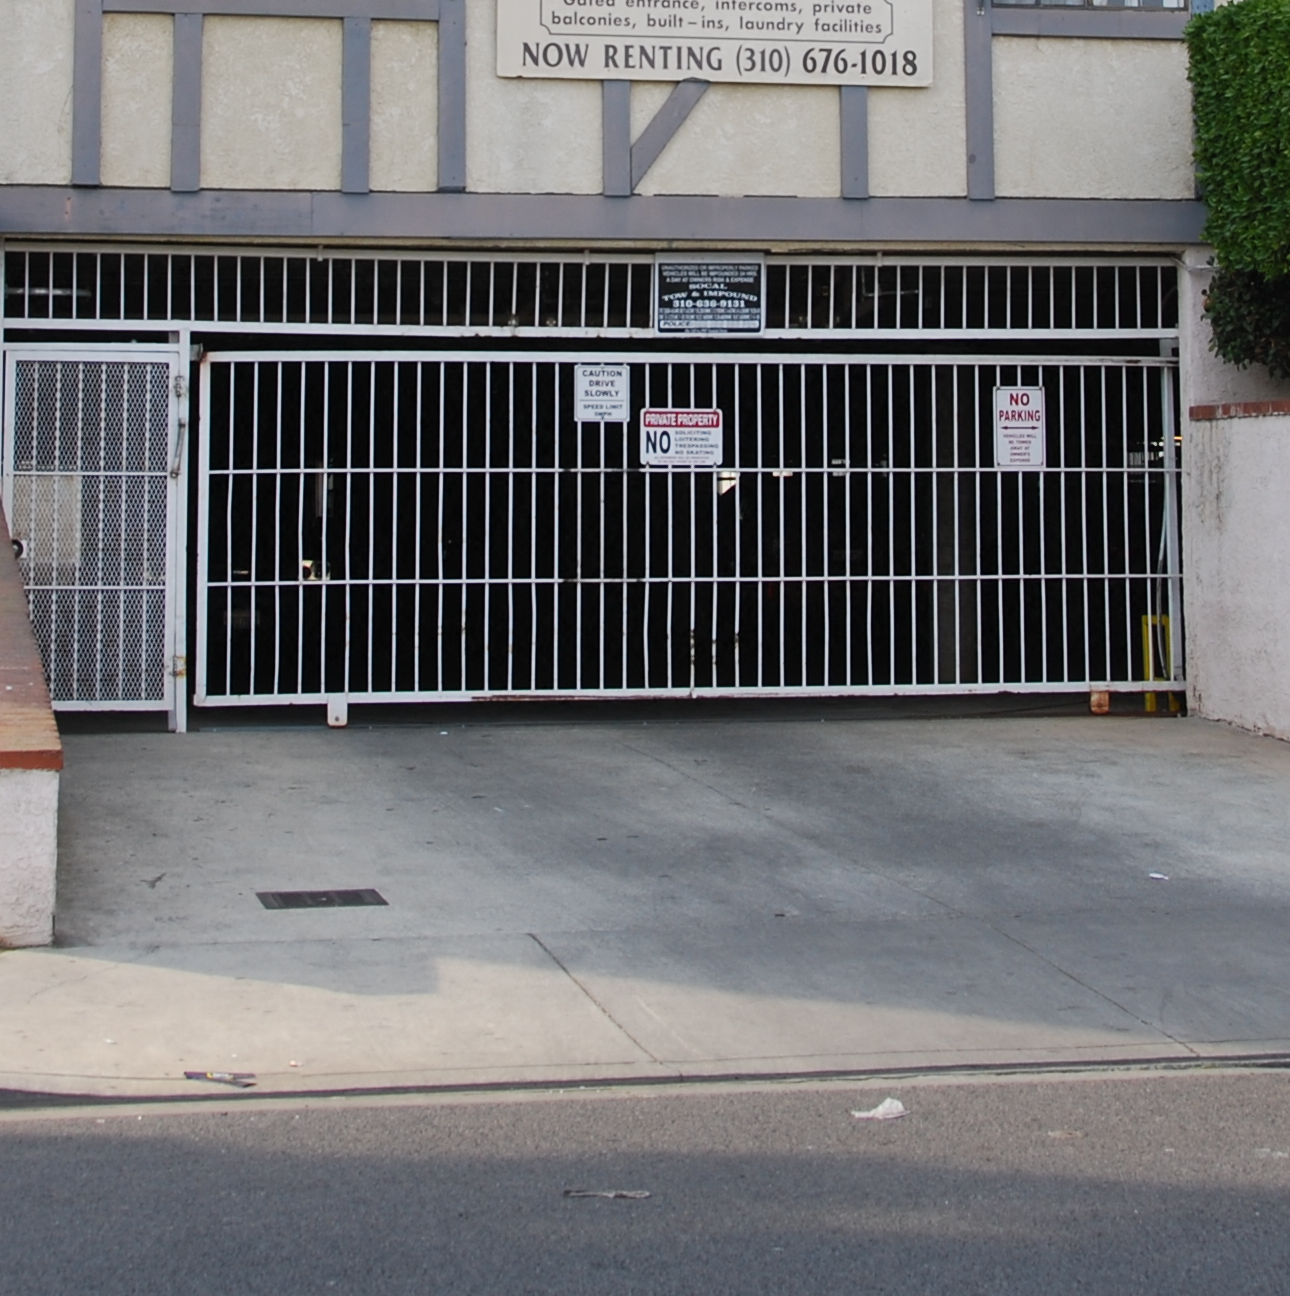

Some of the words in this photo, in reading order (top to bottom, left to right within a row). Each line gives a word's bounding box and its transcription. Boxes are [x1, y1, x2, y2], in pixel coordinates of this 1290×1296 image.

[813, 0, 872, 16] private
[551, 10, 637, 29] balconies,
[740, 16, 805, 35] laundry
[814, 18, 882, 34] facilities
[522, 42, 589, 68] NOW
[604, 44, 723, 72] RENTING
[736, 45, 791, 77] (310)
[802, 47, 918, 77] 676-1018
[662, 291, 688, 302] TOW
[703, 290, 758, 302] IMPOUND
[1009, 393, 1030, 406] NO
[645, 414, 676, 425] PRIVATE
[678, 414, 718, 426] PROPERTY
[999, 410, 1041, 422] PARKING
[646, 430, 671, 454] NO
